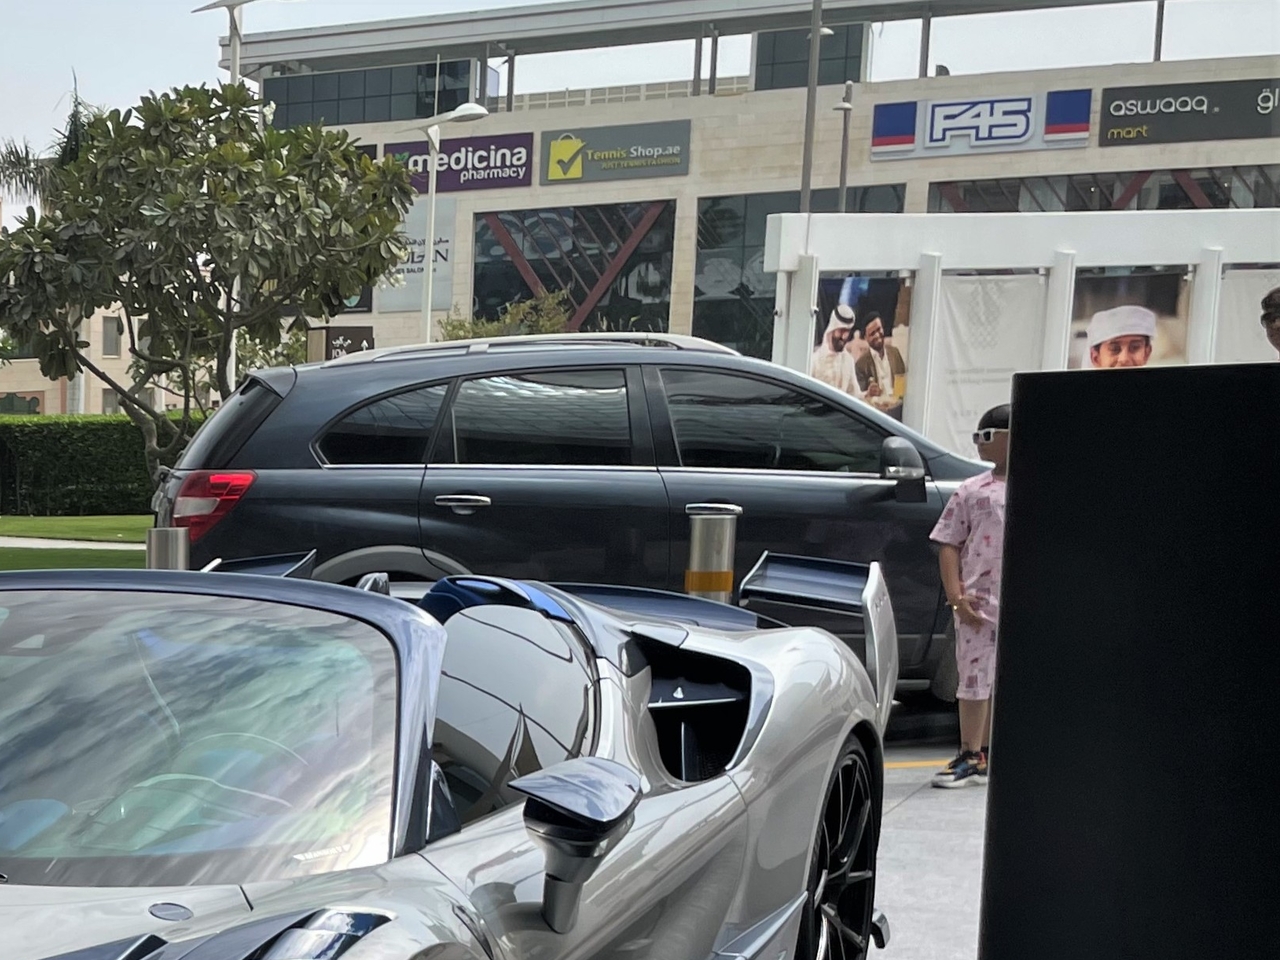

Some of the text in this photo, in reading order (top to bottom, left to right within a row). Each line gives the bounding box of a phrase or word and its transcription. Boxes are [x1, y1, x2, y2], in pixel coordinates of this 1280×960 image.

[1109, 95, 1208, 116] aswaaq
[928, 97, 1033, 143] F45
[1107, 125, 1149, 140] mart
[408, 144, 528, 173] medicina
[586, 145, 681, 161] Tennis Shop.ae
[460, 166, 527, 184] pharmacy
